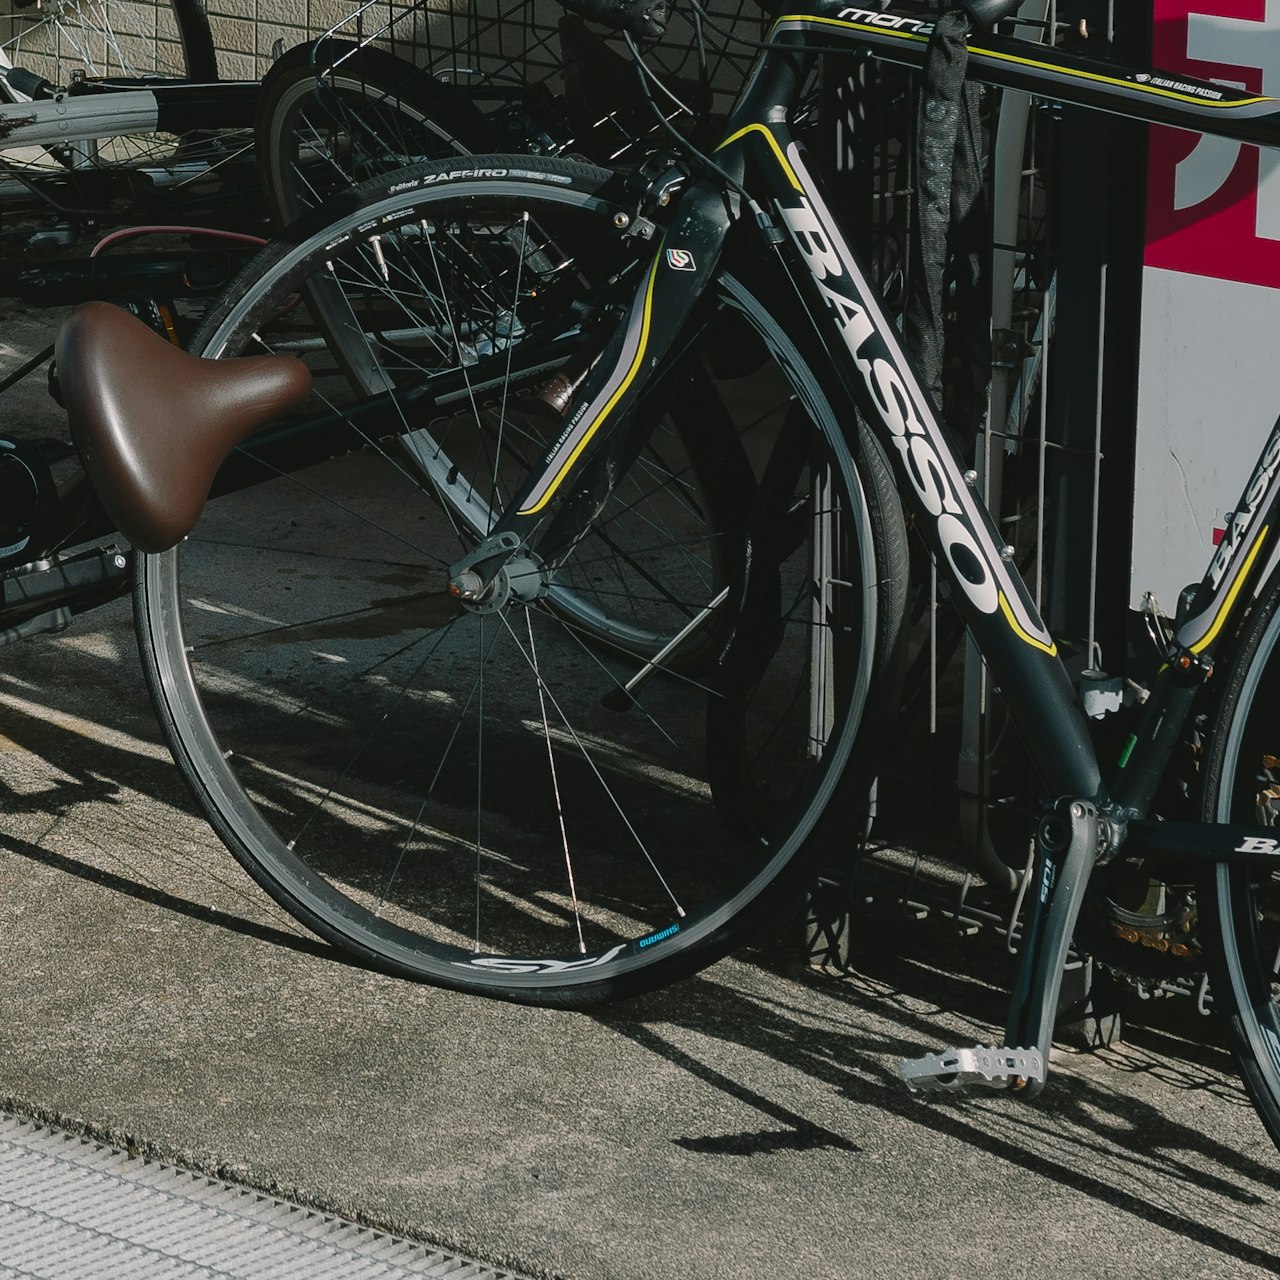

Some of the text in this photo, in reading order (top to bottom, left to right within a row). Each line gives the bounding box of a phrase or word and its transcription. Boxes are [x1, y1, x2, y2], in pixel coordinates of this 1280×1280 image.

[1150, 76, 1223, 101] ITALIAN RACING PASSION
[424, 169, 509, 185] ZAFFIRO
[774, 196, 999, 614] BASSO
[545, 402, 589, 464] ITALIAN RACING PASSION
[1040, 857, 1053, 906] 105
[638, 924, 680, 949] SHIMANO
